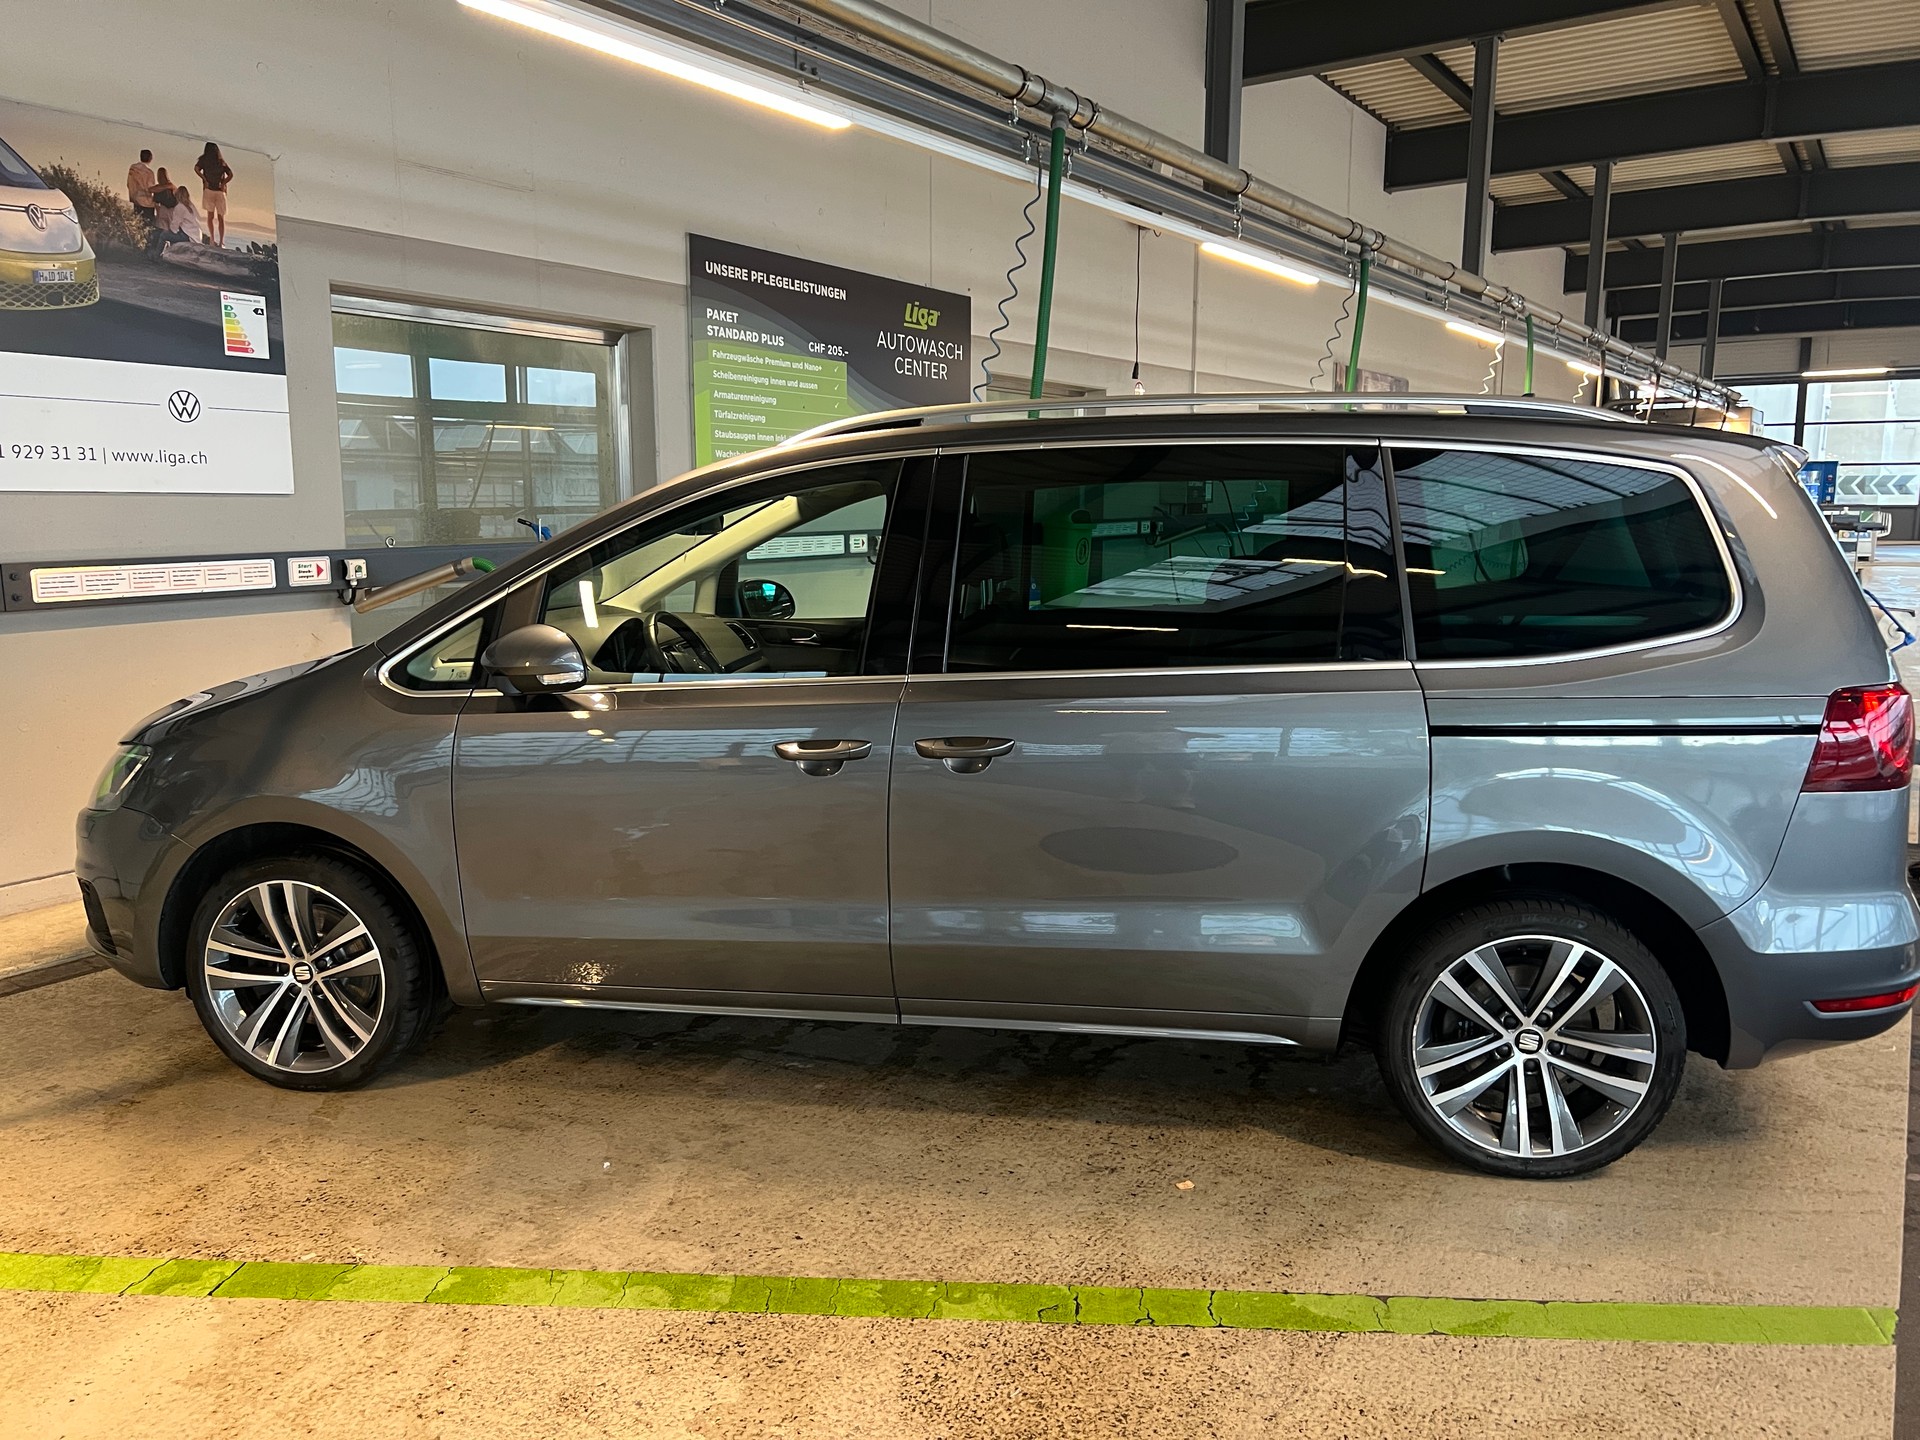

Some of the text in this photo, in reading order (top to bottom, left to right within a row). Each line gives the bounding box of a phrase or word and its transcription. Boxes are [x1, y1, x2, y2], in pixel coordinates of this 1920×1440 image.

[705, 260, 847, 301] UNSERE PFLEGELEISTUNGEN
[706, 307, 739, 324] PAKET
[707, 325, 785, 347] STANDARD PLUS
[876, 330, 963, 361] AUTOWASCH
[808, 342, 826, 354] CHF
[712, 349, 763, 364] Fahrzeugwäsche
[764, 356, 791, 367] Premium
[792, 360, 803, 370] und
[894, 356, 948, 380] CENTER
[712, 370, 769, 385] Scheibenreinigung
[787, 379, 798, 388] und
[799, 381, 818, 390] aussen
[713, 390, 777, 405] Armaturenreinigung
[714, 410, 766, 424] Türfalzreinigung
[714, 429, 756, 441] Staubsaugen
[11, 444, 45, 460] 929
[51, 445, 71, 461] 31
[77, 446, 97, 461] 31
[111, 449, 208, 467] www.liga.ch
